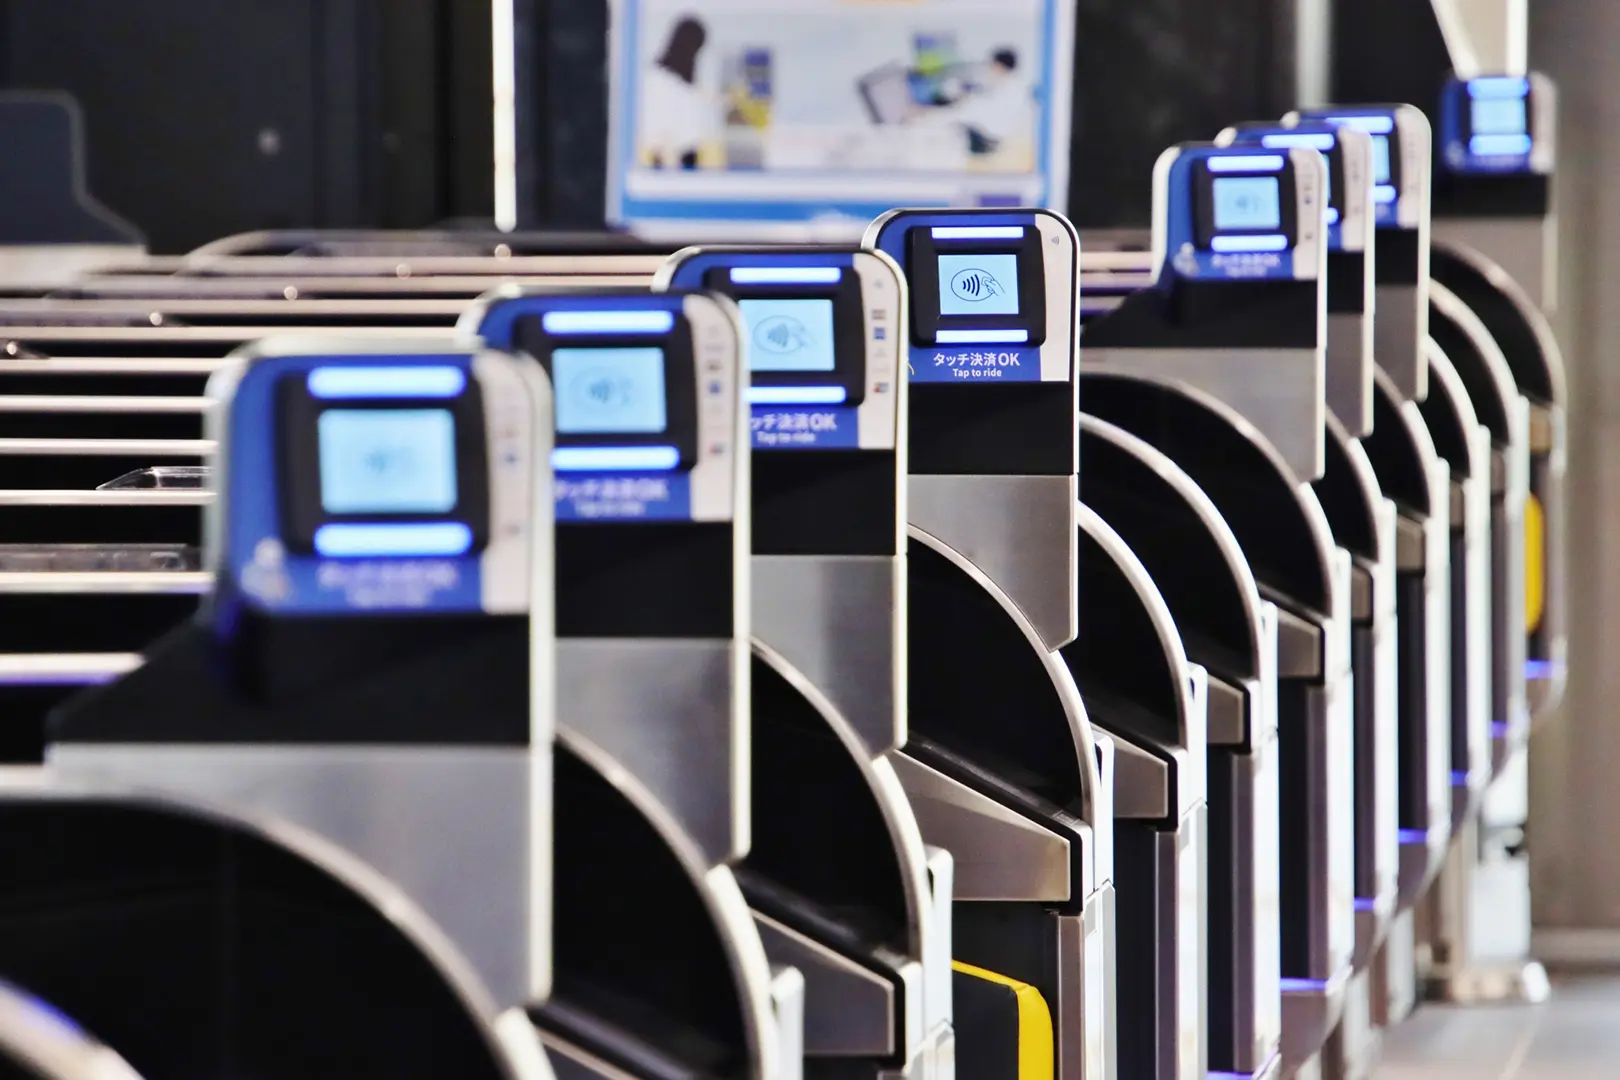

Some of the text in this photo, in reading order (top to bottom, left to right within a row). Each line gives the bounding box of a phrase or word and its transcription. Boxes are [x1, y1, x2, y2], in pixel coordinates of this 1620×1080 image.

[933, 352, 1020, 366] タッチ決済OK
[953, 367, 1002, 379] Tap to ride
